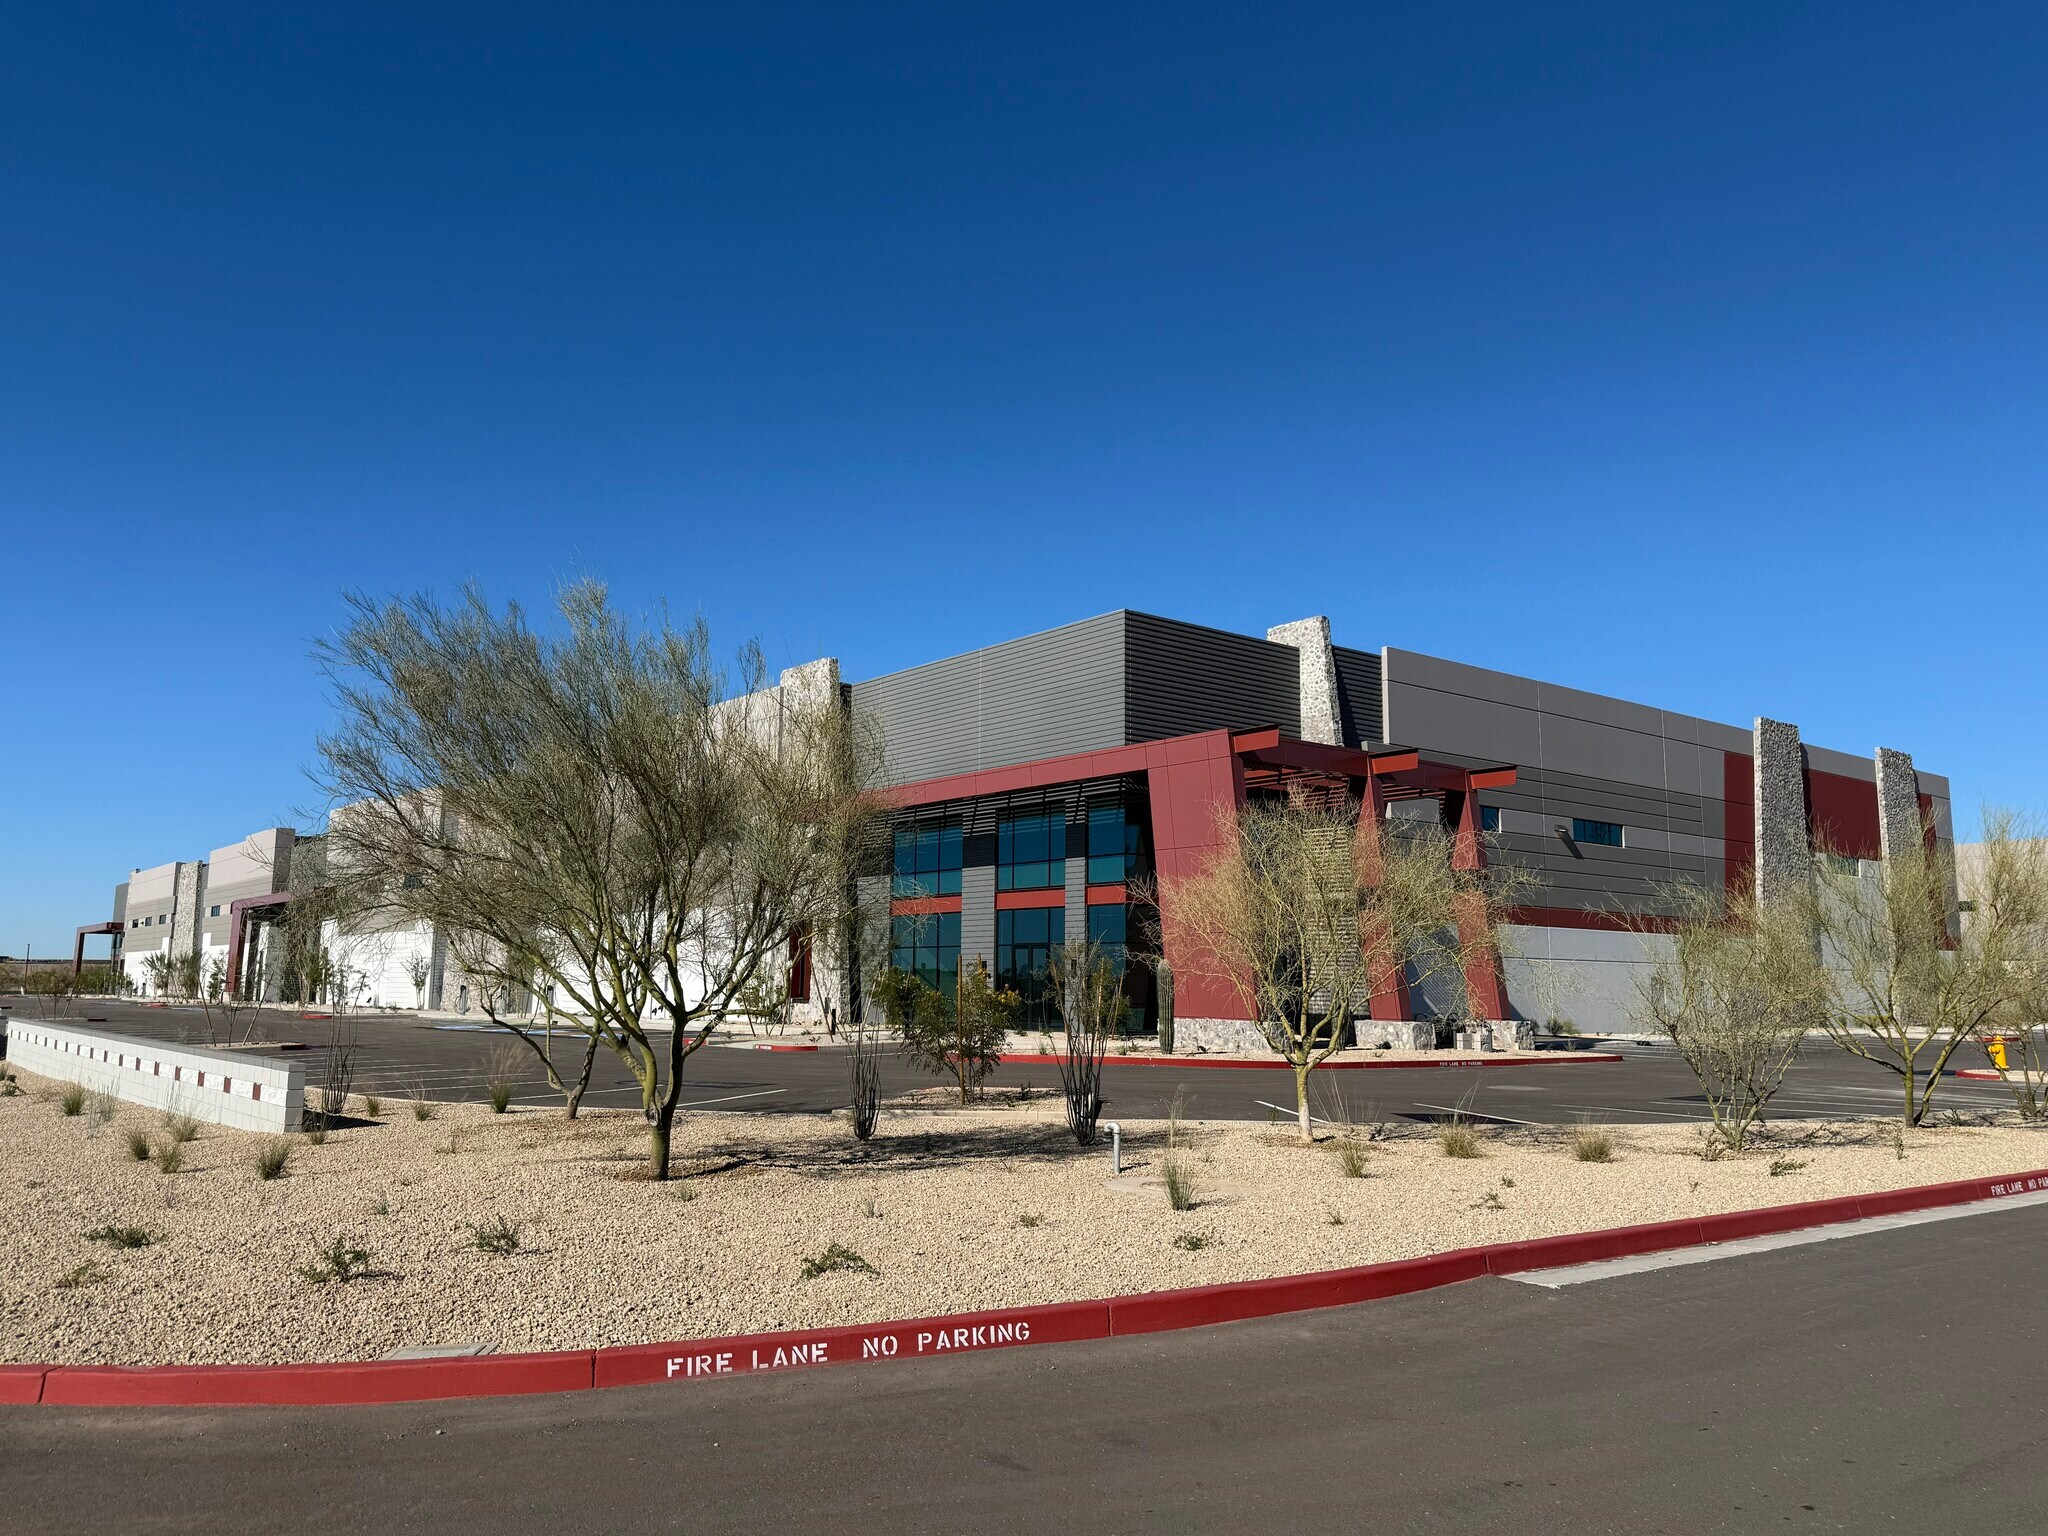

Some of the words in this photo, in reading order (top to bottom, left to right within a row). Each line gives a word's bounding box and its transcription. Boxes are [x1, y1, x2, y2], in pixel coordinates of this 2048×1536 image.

[1991, 1184, 2006, 1196] FIRE
[2007, 1181, 2023, 1193] LANE
[2027, 1179, 2037, 1189] NO
[667, 1353, 733, 1378] FIRE
[752, 1343, 829, 1370] LANE
[862, 1336, 898, 1359] NO
[917, 1322, 1031, 1352] PARKING
